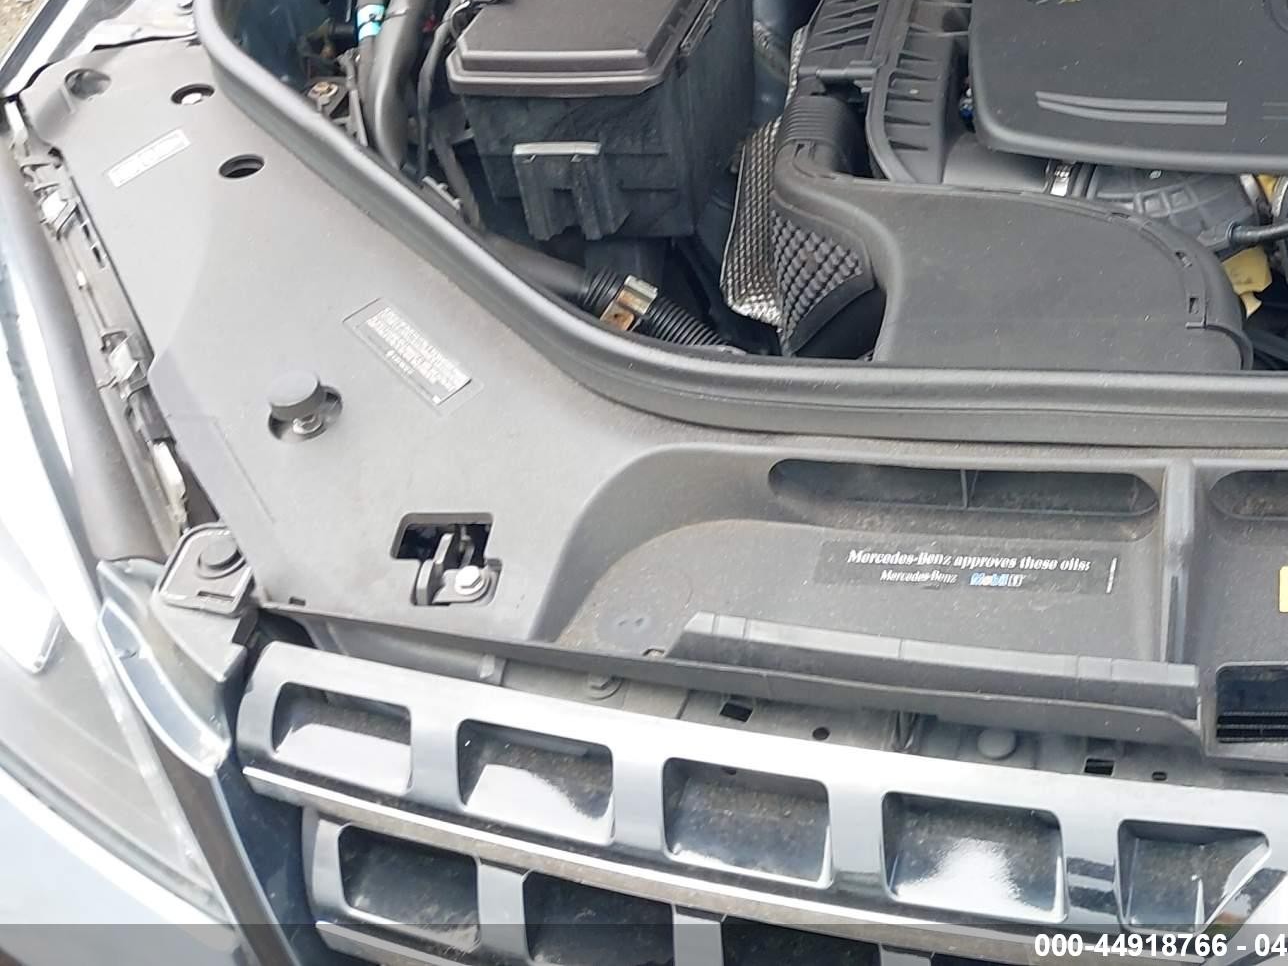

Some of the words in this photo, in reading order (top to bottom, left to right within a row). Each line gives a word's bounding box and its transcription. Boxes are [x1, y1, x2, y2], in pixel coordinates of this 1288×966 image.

[847, 549, 952, 565] Mercedes-Benz
[953, 555, 1017, 570] approves
[1019, 556, 1058, 570] these
[879, 569, 959, 584] Mercedes-Benz
